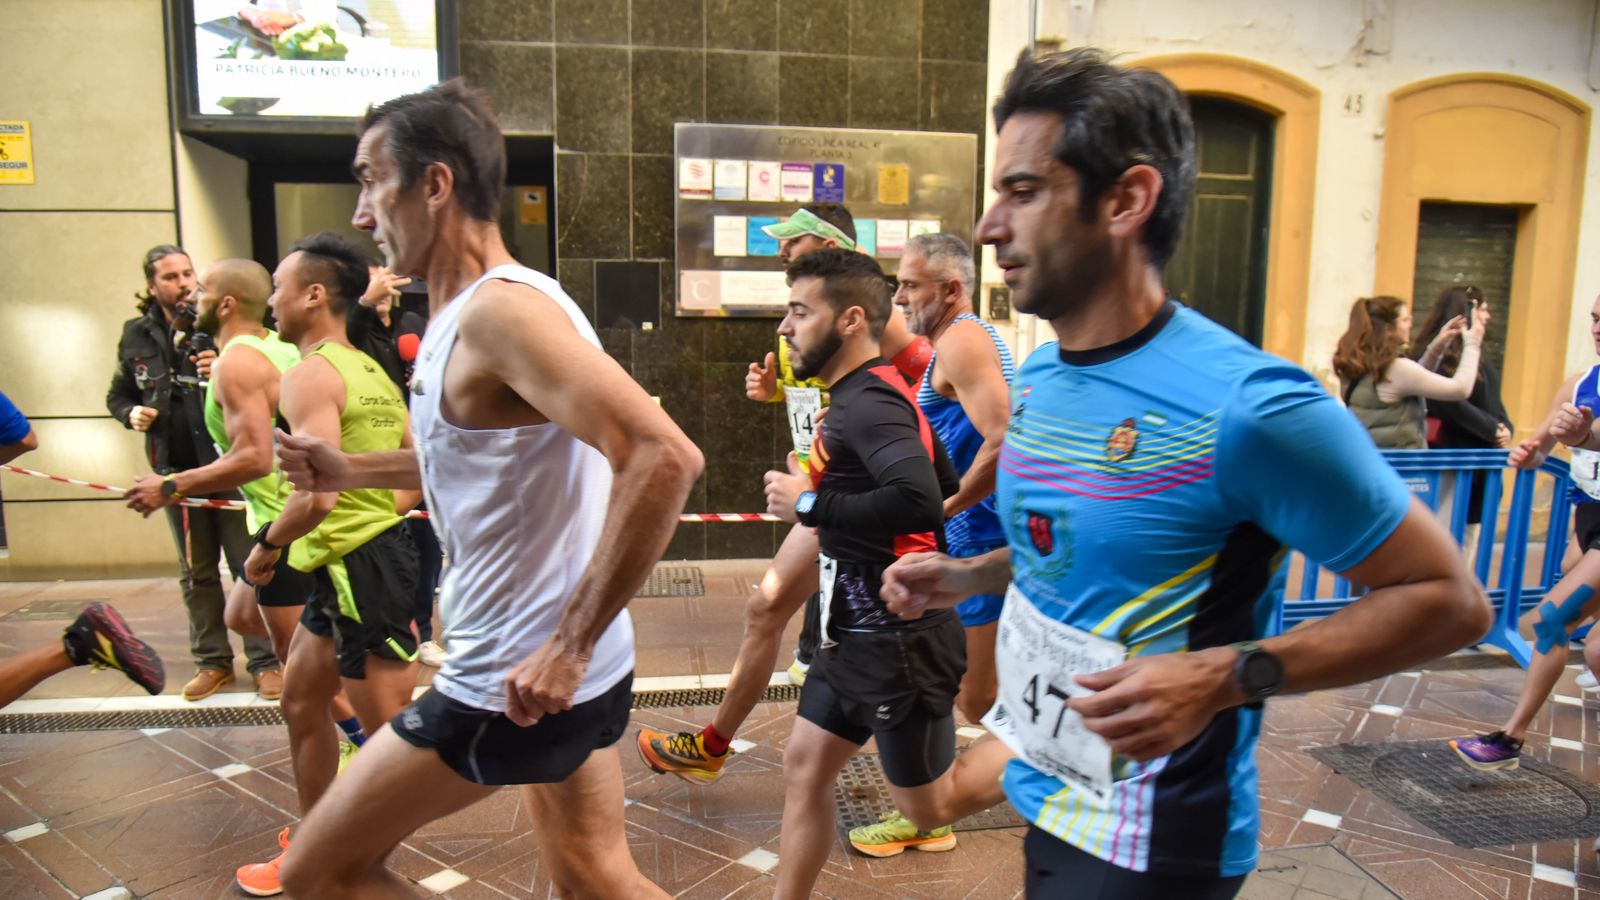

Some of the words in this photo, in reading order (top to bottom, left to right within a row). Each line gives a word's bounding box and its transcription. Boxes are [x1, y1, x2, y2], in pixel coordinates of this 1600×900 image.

[215, 63, 284, 74] PATRICIA
[290, 65, 341, 77] BUENO
[346, 67, 421, 79] MONTERO
[810, 149, 845, 158] PLANTA
